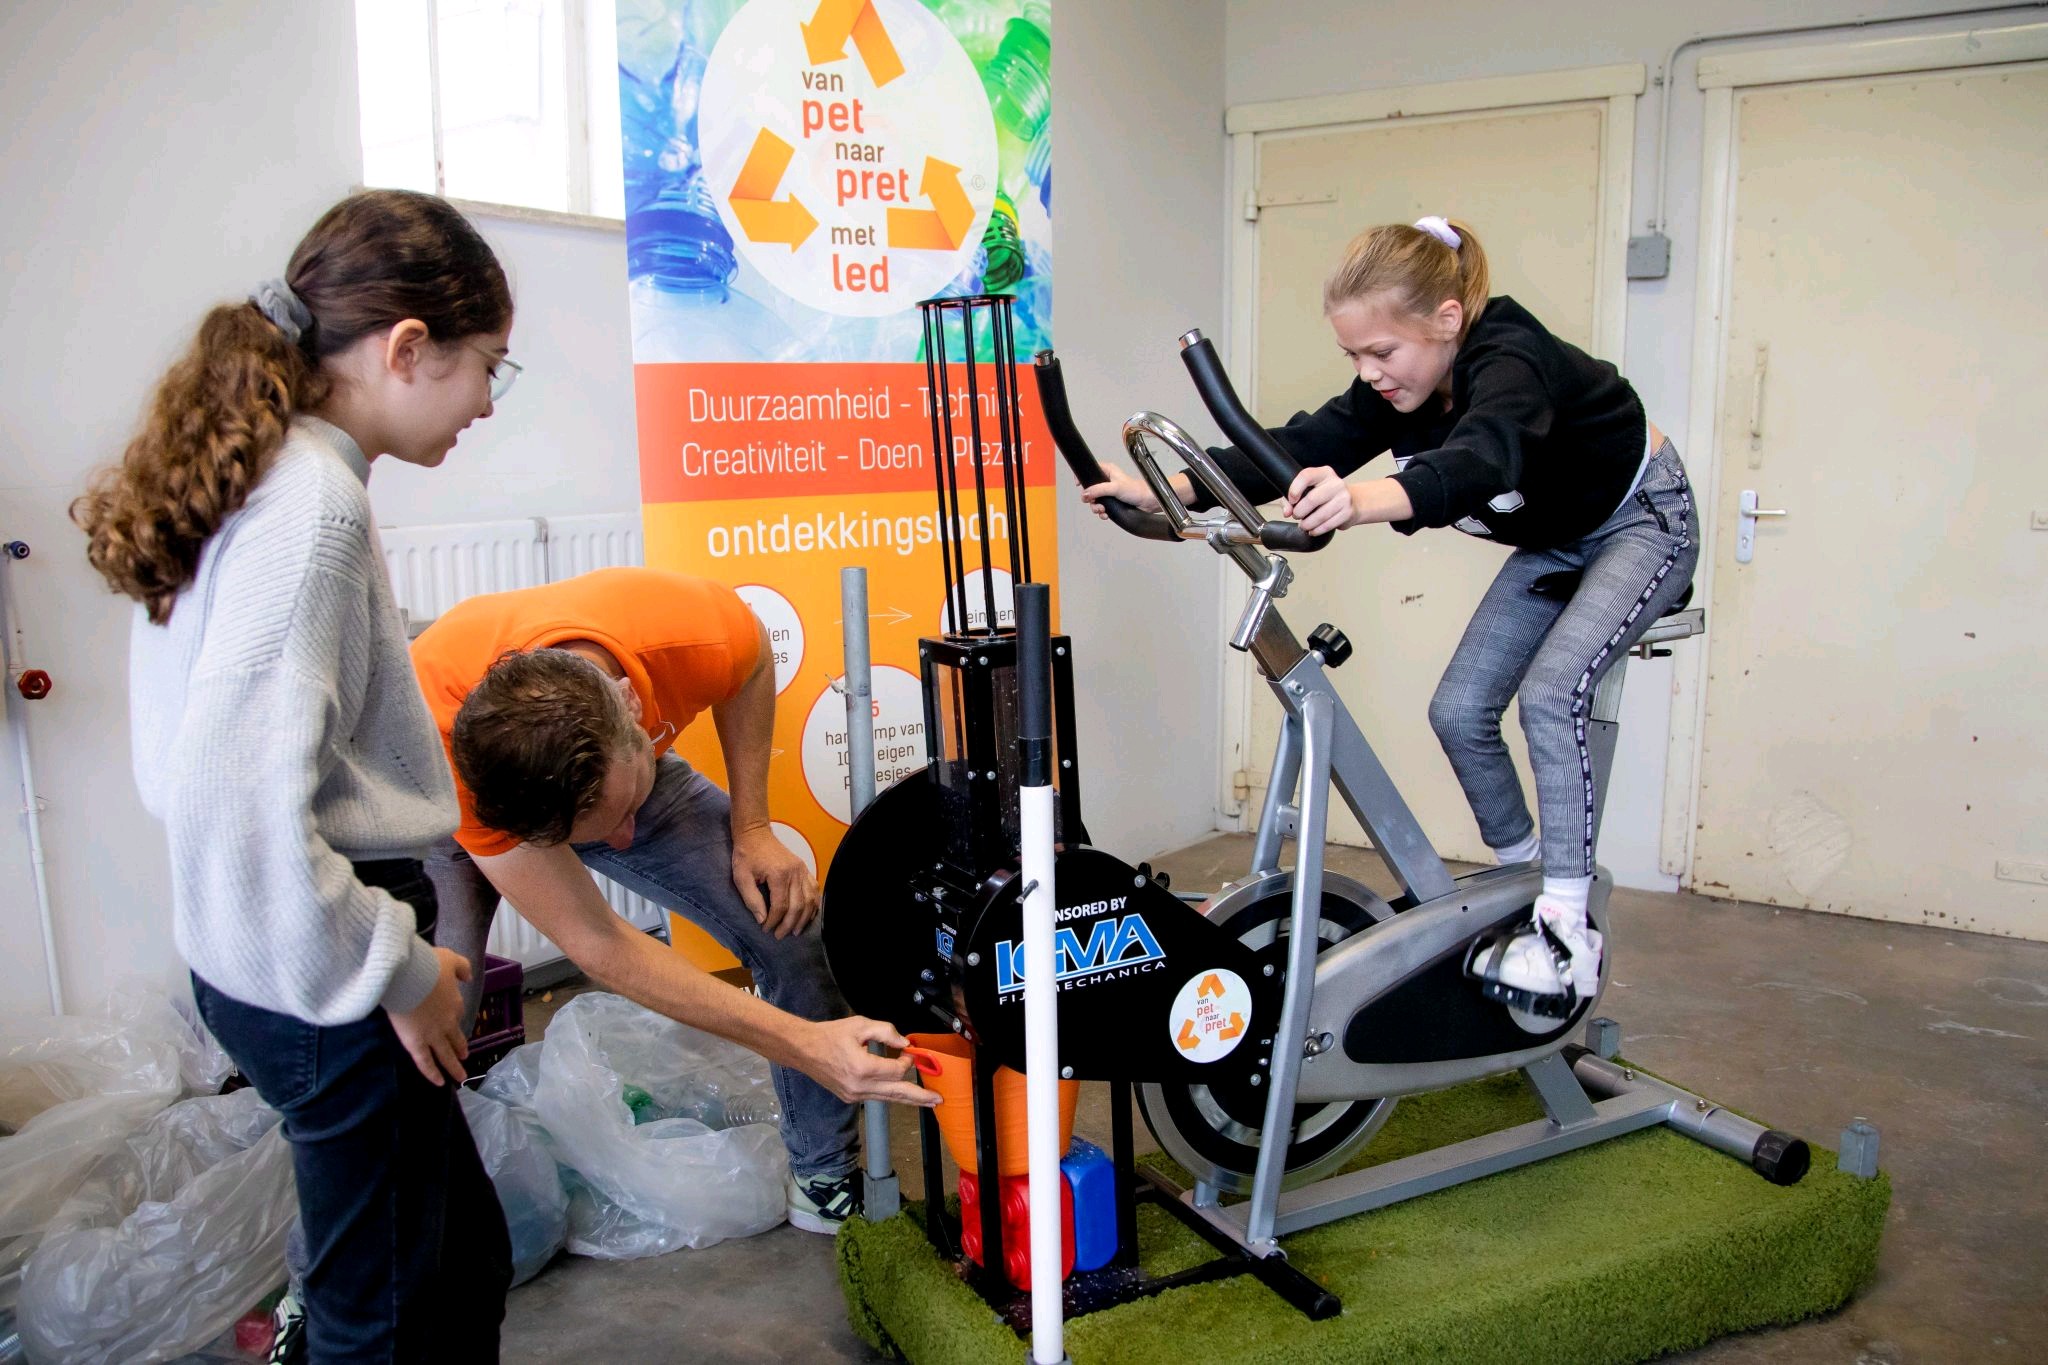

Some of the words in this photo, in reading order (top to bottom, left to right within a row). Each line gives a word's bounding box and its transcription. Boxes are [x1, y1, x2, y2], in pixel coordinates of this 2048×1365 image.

[801, 70, 844, 92] van
[802, 98, 865, 139] pet
[835, 141, 885, 163] naar
[836, 168, 910, 207] pret
[831, 225, 876, 246] met
[832, 253, 889, 293] led
[689, 385, 890, 423] Duurzaamheid
[682, 441, 827, 477] Creativiteit
[859, 438, 922, 471] Doen
[953, 436, 1032, 467] Plezer
[900, 722, 924, 737] van
[877, 745, 915, 762] eigen
[1055, 900, 1107, 922] NSORED
[1110, 896, 1127, 911] BY
[999, 961, 1166, 1005] FIJECHANICA
[1197, 1003, 1214, 1018] pet
[1205, 1018, 1227, 1034] pret
